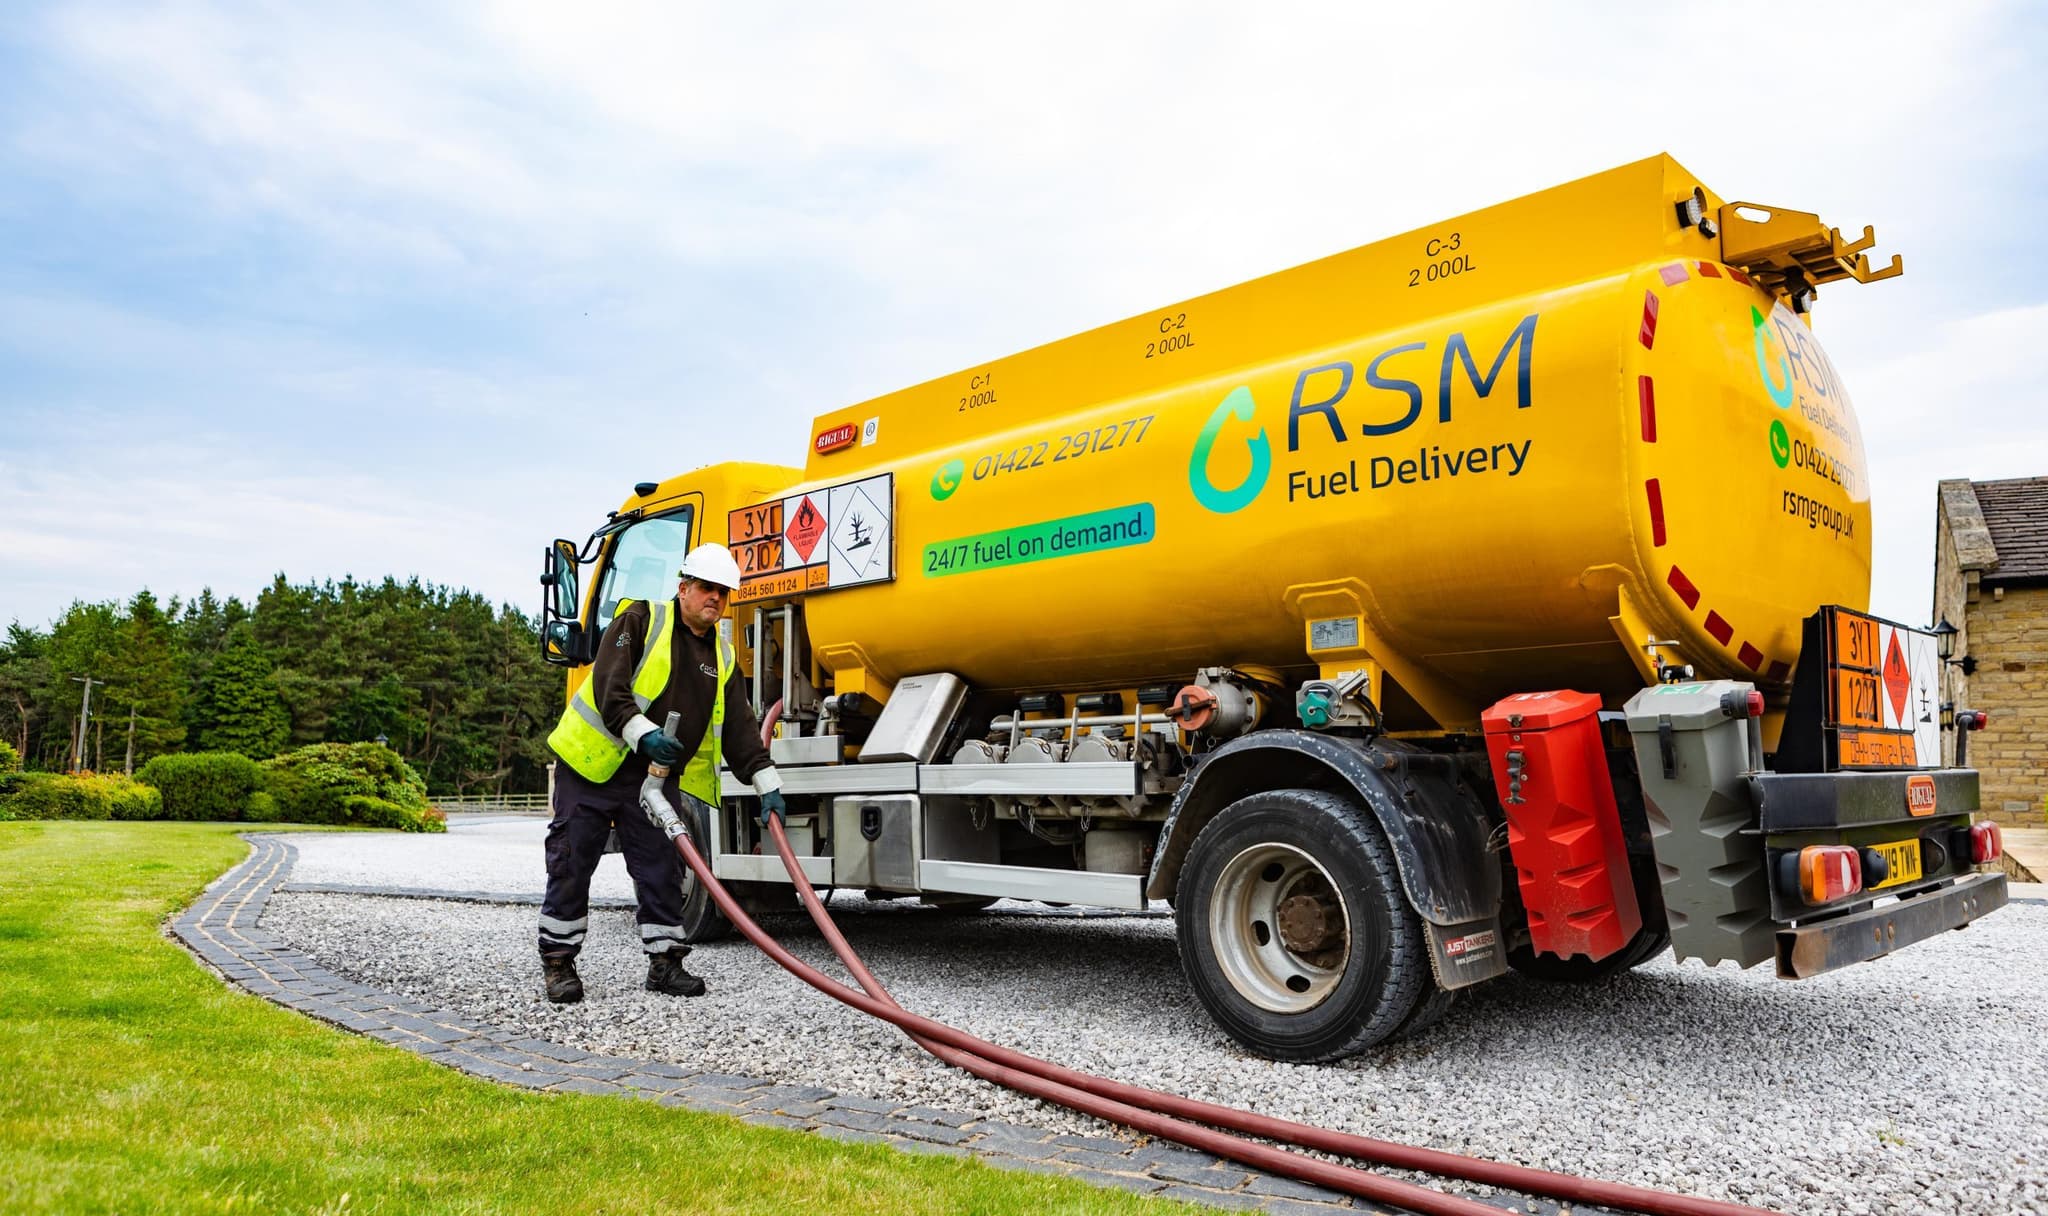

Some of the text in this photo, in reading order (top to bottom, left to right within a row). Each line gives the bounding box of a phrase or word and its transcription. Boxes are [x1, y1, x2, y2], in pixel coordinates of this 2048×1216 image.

[1426, 233, 1461, 256] C-3
[1408, 254, 1476, 287] 2 000L
[1160, 313, 1186, 333] C-2
[1145, 332, 1194, 358] 2 000L
[1774, 316, 1845, 414] RSM
[971, 373, 990, 390] C-1
[1288, 313, 1539, 452] RSM
[959, 390, 997, 412] 2 000L
[1799, 395, 1823, 426] Fuel
[817, 427, 850, 448] RIGUAL
[972, 415, 1155, 480] 01422 291277
[1288, 440, 1532, 502] Fuel Delivery
[1794, 439, 1828, 478] 01422
[1783, 490, 1854, 540] rsmgroup.uk
[927, 512, 1148, 572] 24/7 fuel on demand.
[738, 585, 757, 599] 0844
[760, 582, 774, 595] 560
[777, 578, 797, 592] 1124
